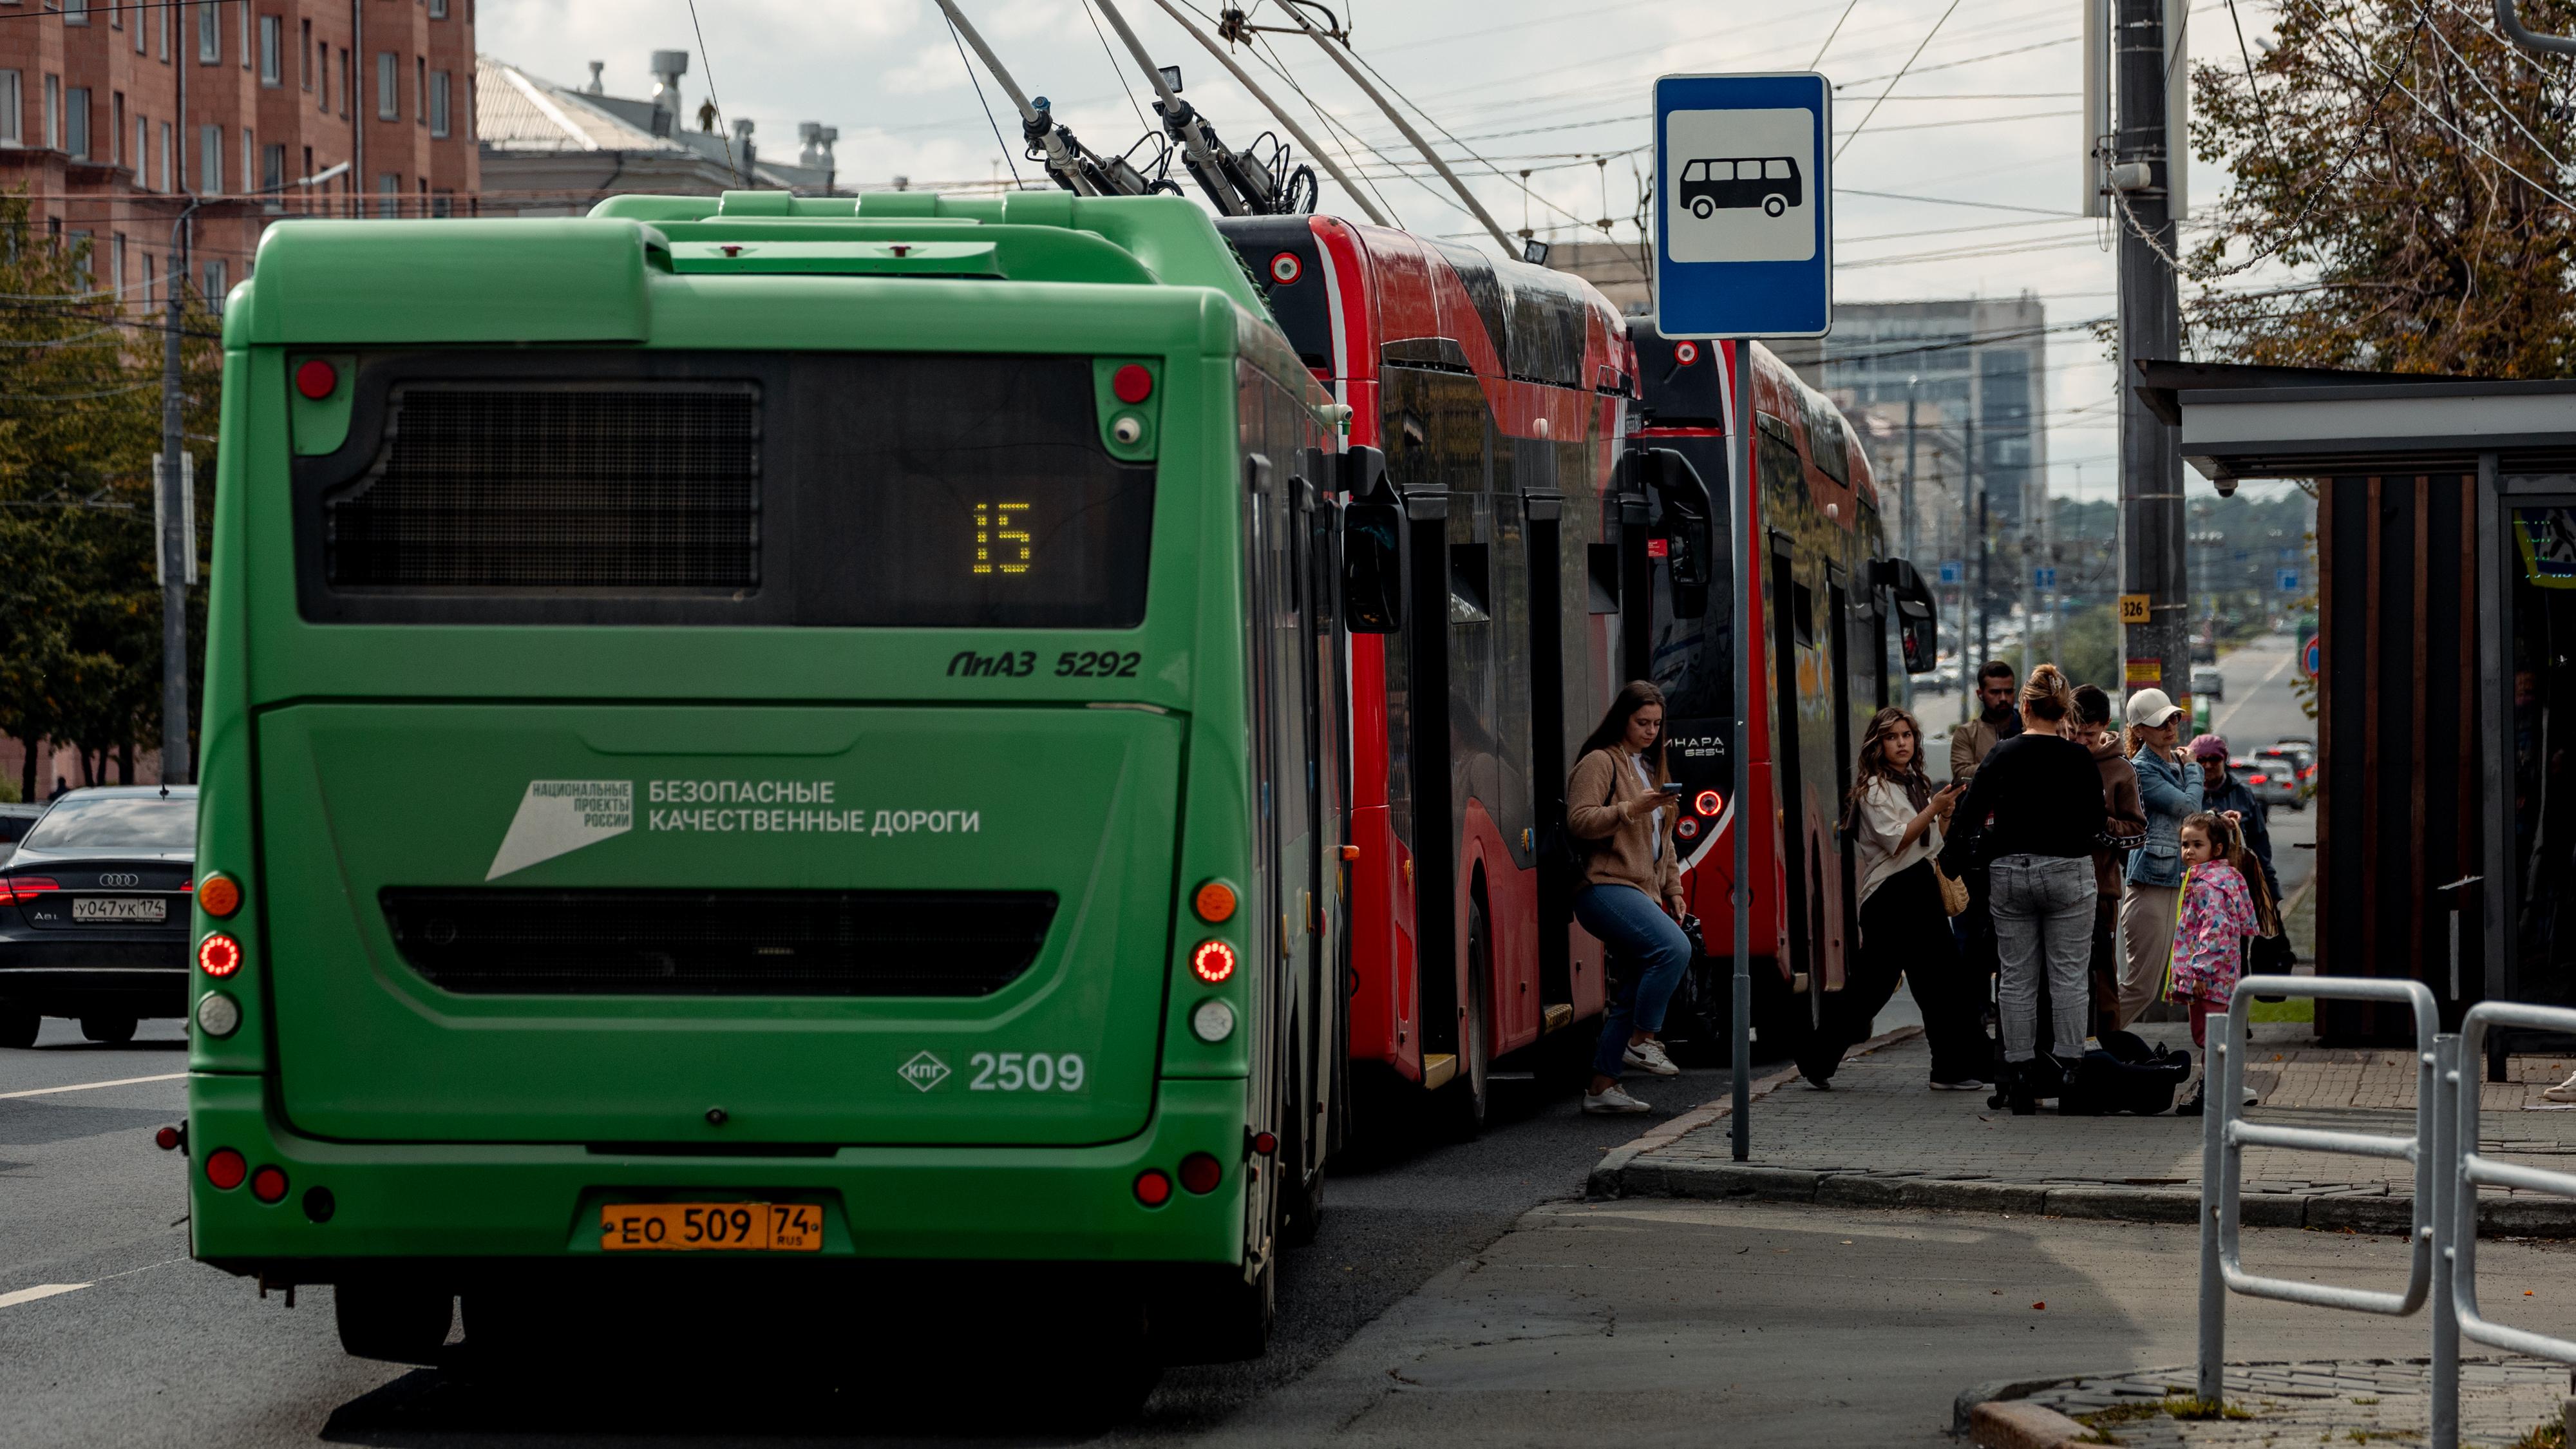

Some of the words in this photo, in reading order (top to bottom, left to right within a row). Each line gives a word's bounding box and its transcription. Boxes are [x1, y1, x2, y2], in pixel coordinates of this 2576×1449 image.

[974, 504, 1030, 573] 15
[2124, 602, 2143, 616] 326
[1054, 650, 1141, 677] 5292
[1663, 737, 1724, 747] ИНАРА
[1685, 748, 1725, 757] 6254
[533, 783, 629, 798] НАЦИОНАЛЬНЫЕ
[649, 781, 835, 803] БЕЗОПАСНЫЕ
[574, 799, 629, 812] ПРОЕКТЫ
[584, 814, 629, 827] РОССИИ
[649, 810, 865, 831] КАЧЕСТВЕННЫЕ
[871, 810, 980, 837] ДОРОГИ
[140, 900, 161, 913] 174
[908, 1065, 941, 1078] КПГ
[970, 1052, 1084, 1091] 2509
[683, 1208, 752, 1243] 509
[774, 1208, 808, 1235] 74
[777, 1236, 803, 1246] RUS
